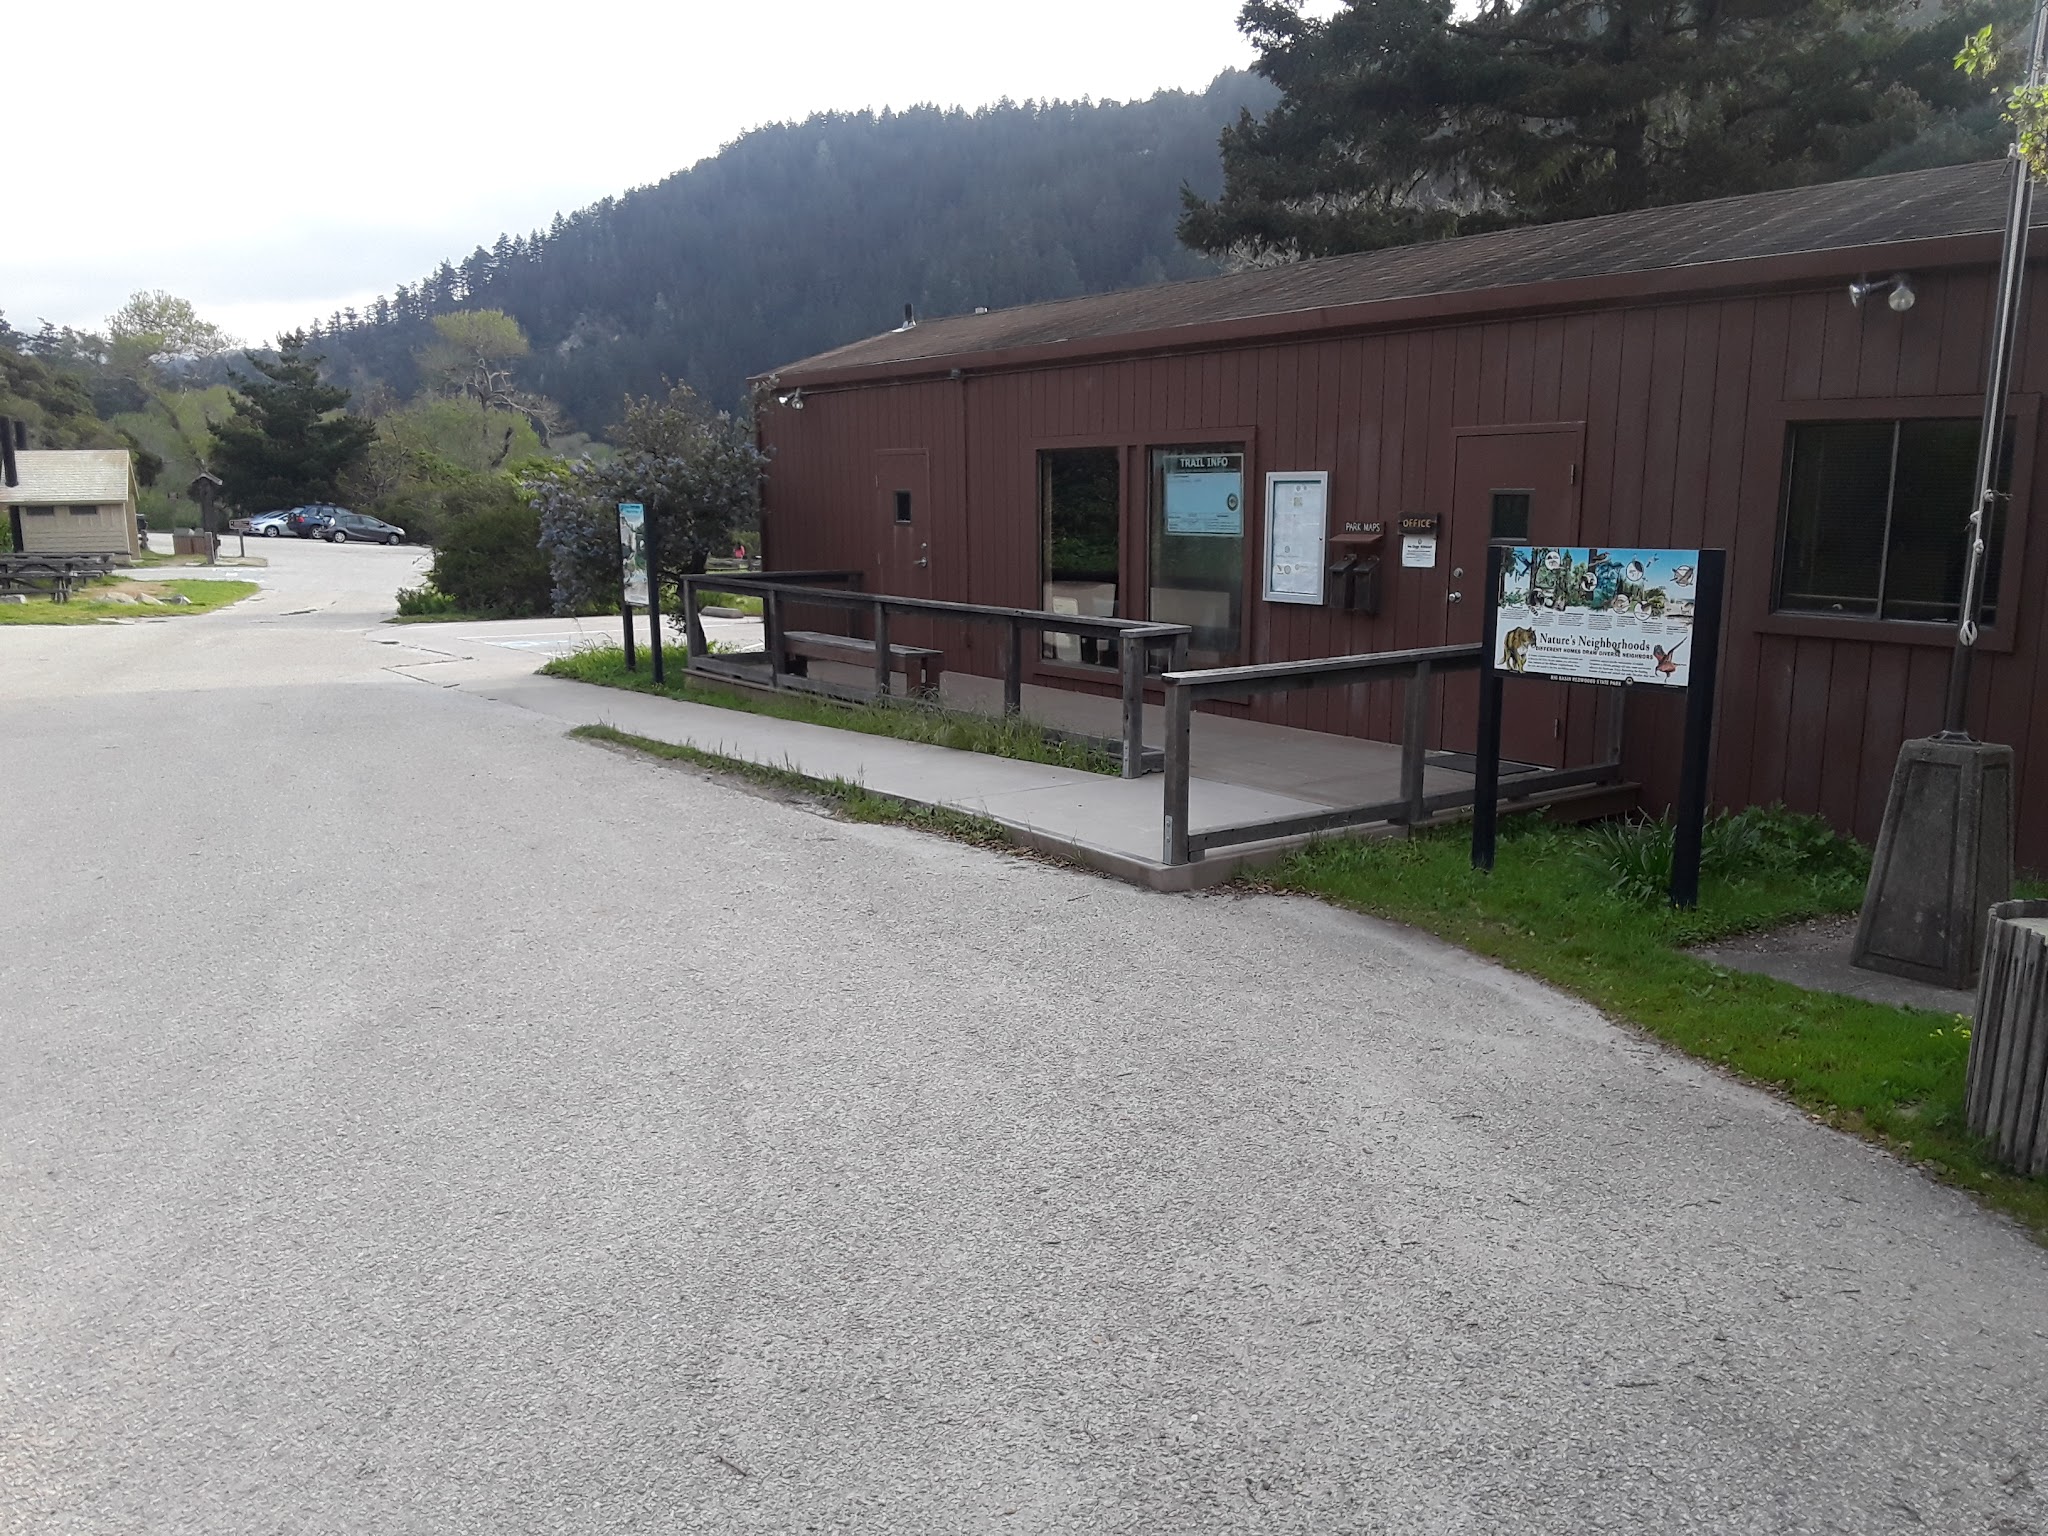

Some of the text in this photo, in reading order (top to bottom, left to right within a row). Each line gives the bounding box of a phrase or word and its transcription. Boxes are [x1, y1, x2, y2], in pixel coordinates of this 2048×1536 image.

[1180, 457, 1228, 467] TRAIL INFO
[1345, 522, 1380, 532] PARK MAPS
[1402, 519, 1431, 527] OFFICE
[1540, 633, 1650, 651] Nature's Neighborhoods
[1535, 645, 1562, 653] DIFFERENT
[1598, 650, 1621, 658] DIVERSE
[1622, 652, 1653, 660] NEIGHBORS
[1572, 676, 1596, 684] REDWOODS
